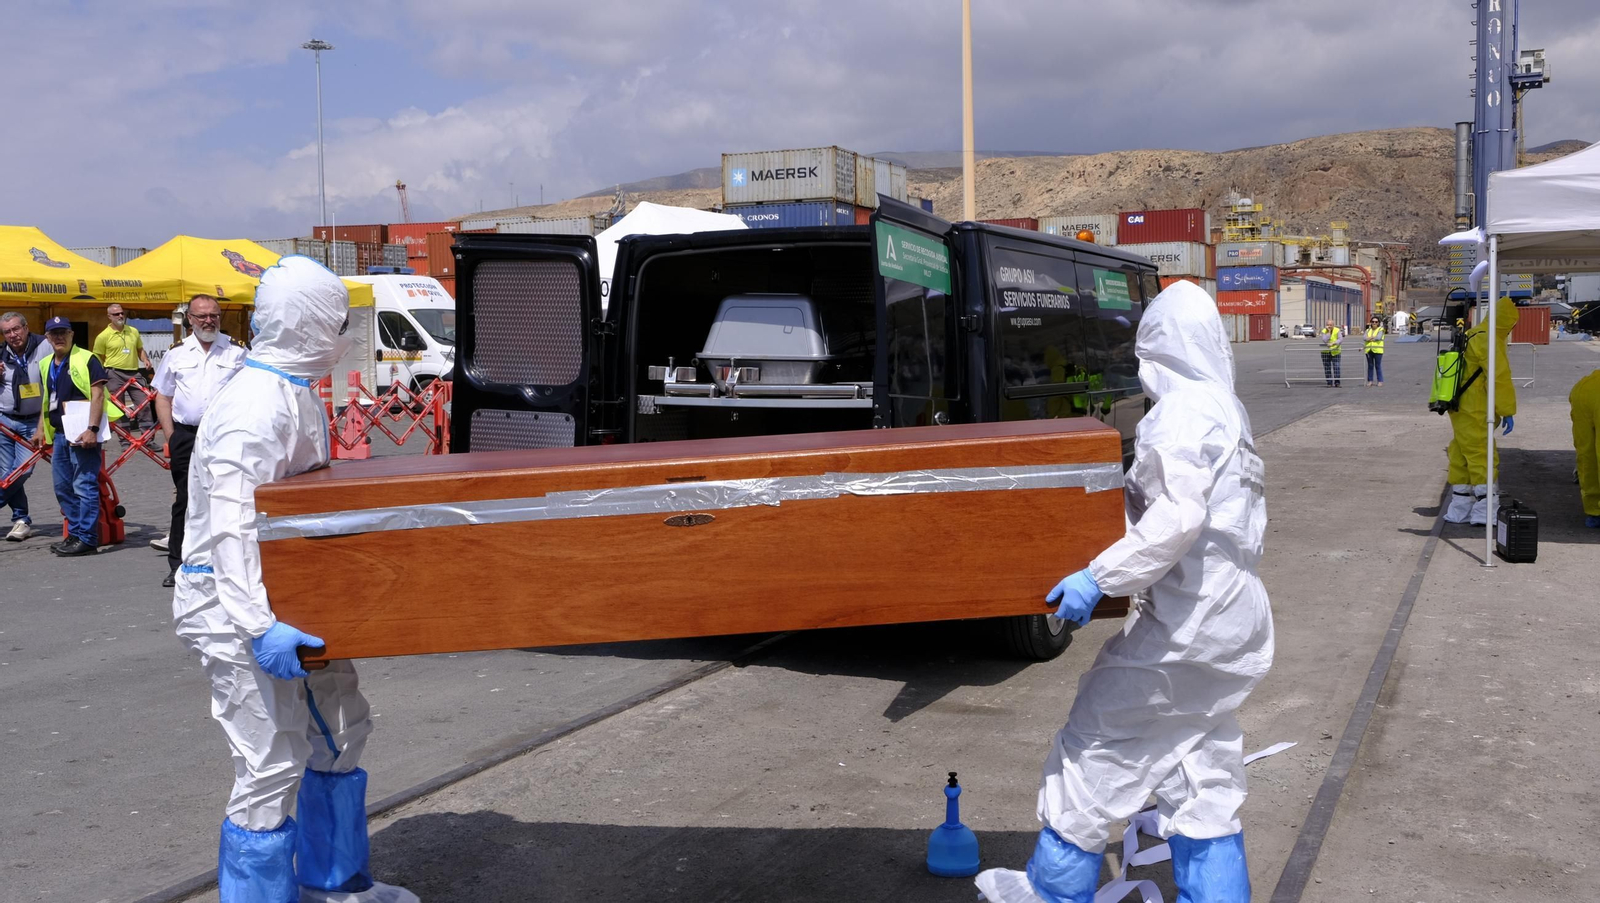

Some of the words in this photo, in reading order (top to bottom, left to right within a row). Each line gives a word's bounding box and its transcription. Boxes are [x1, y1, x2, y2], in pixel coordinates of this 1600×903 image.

[751, 166, 818, 182] MAERSK
[1127, 215, 1145, 224] CAI
[1061, 223, 1101, 232] MAERSK
[395, 237, 426, 245] HABURG
[1146, 253, 1181, 263] ERSK
[1000, 266, 1022, 283] GRUPO
[1023, 268, 1035, 284] ASV
[1, 282, 28, 293] MANDO
[31, 282, 67, 294] AVANZADO
[101, 279, 143, 288] EMERGENCIAS
[1003, 290, 1037, 308] SERVICIOS
[1036, 292, 1070, 309] FUNERARIOS
